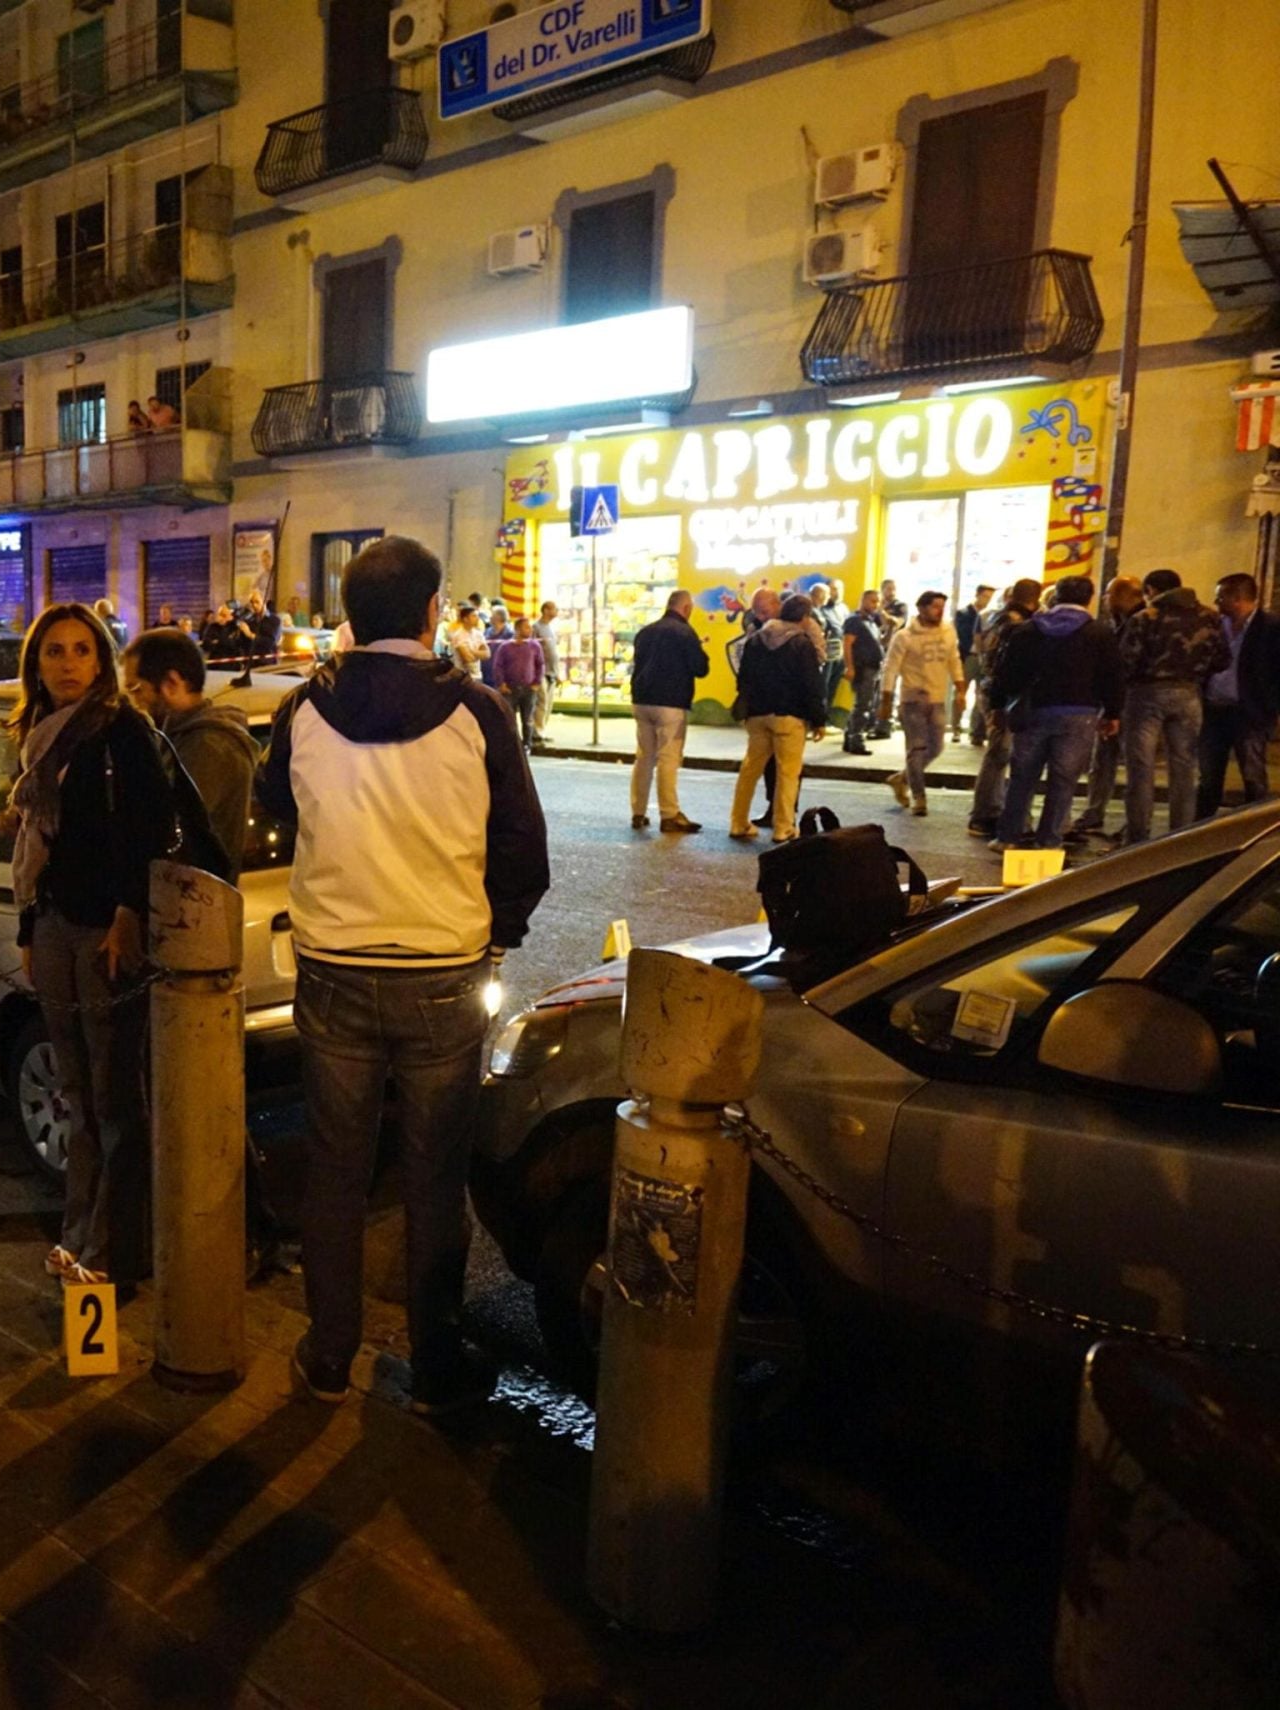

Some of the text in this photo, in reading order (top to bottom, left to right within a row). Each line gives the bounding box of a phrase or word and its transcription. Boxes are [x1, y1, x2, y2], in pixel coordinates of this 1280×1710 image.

[494, 53, 524, 80] del
[532, 43, 561, 71] Dr.
[565, 9, 635, 54] Varelli
[539, 1, 584, 36] CDF
[619, 398, 1013, 506] CAPRICCIO
[689, 500, 859, 541] GIOCATTOLI
[80, 1293, 105, 1355] 2
